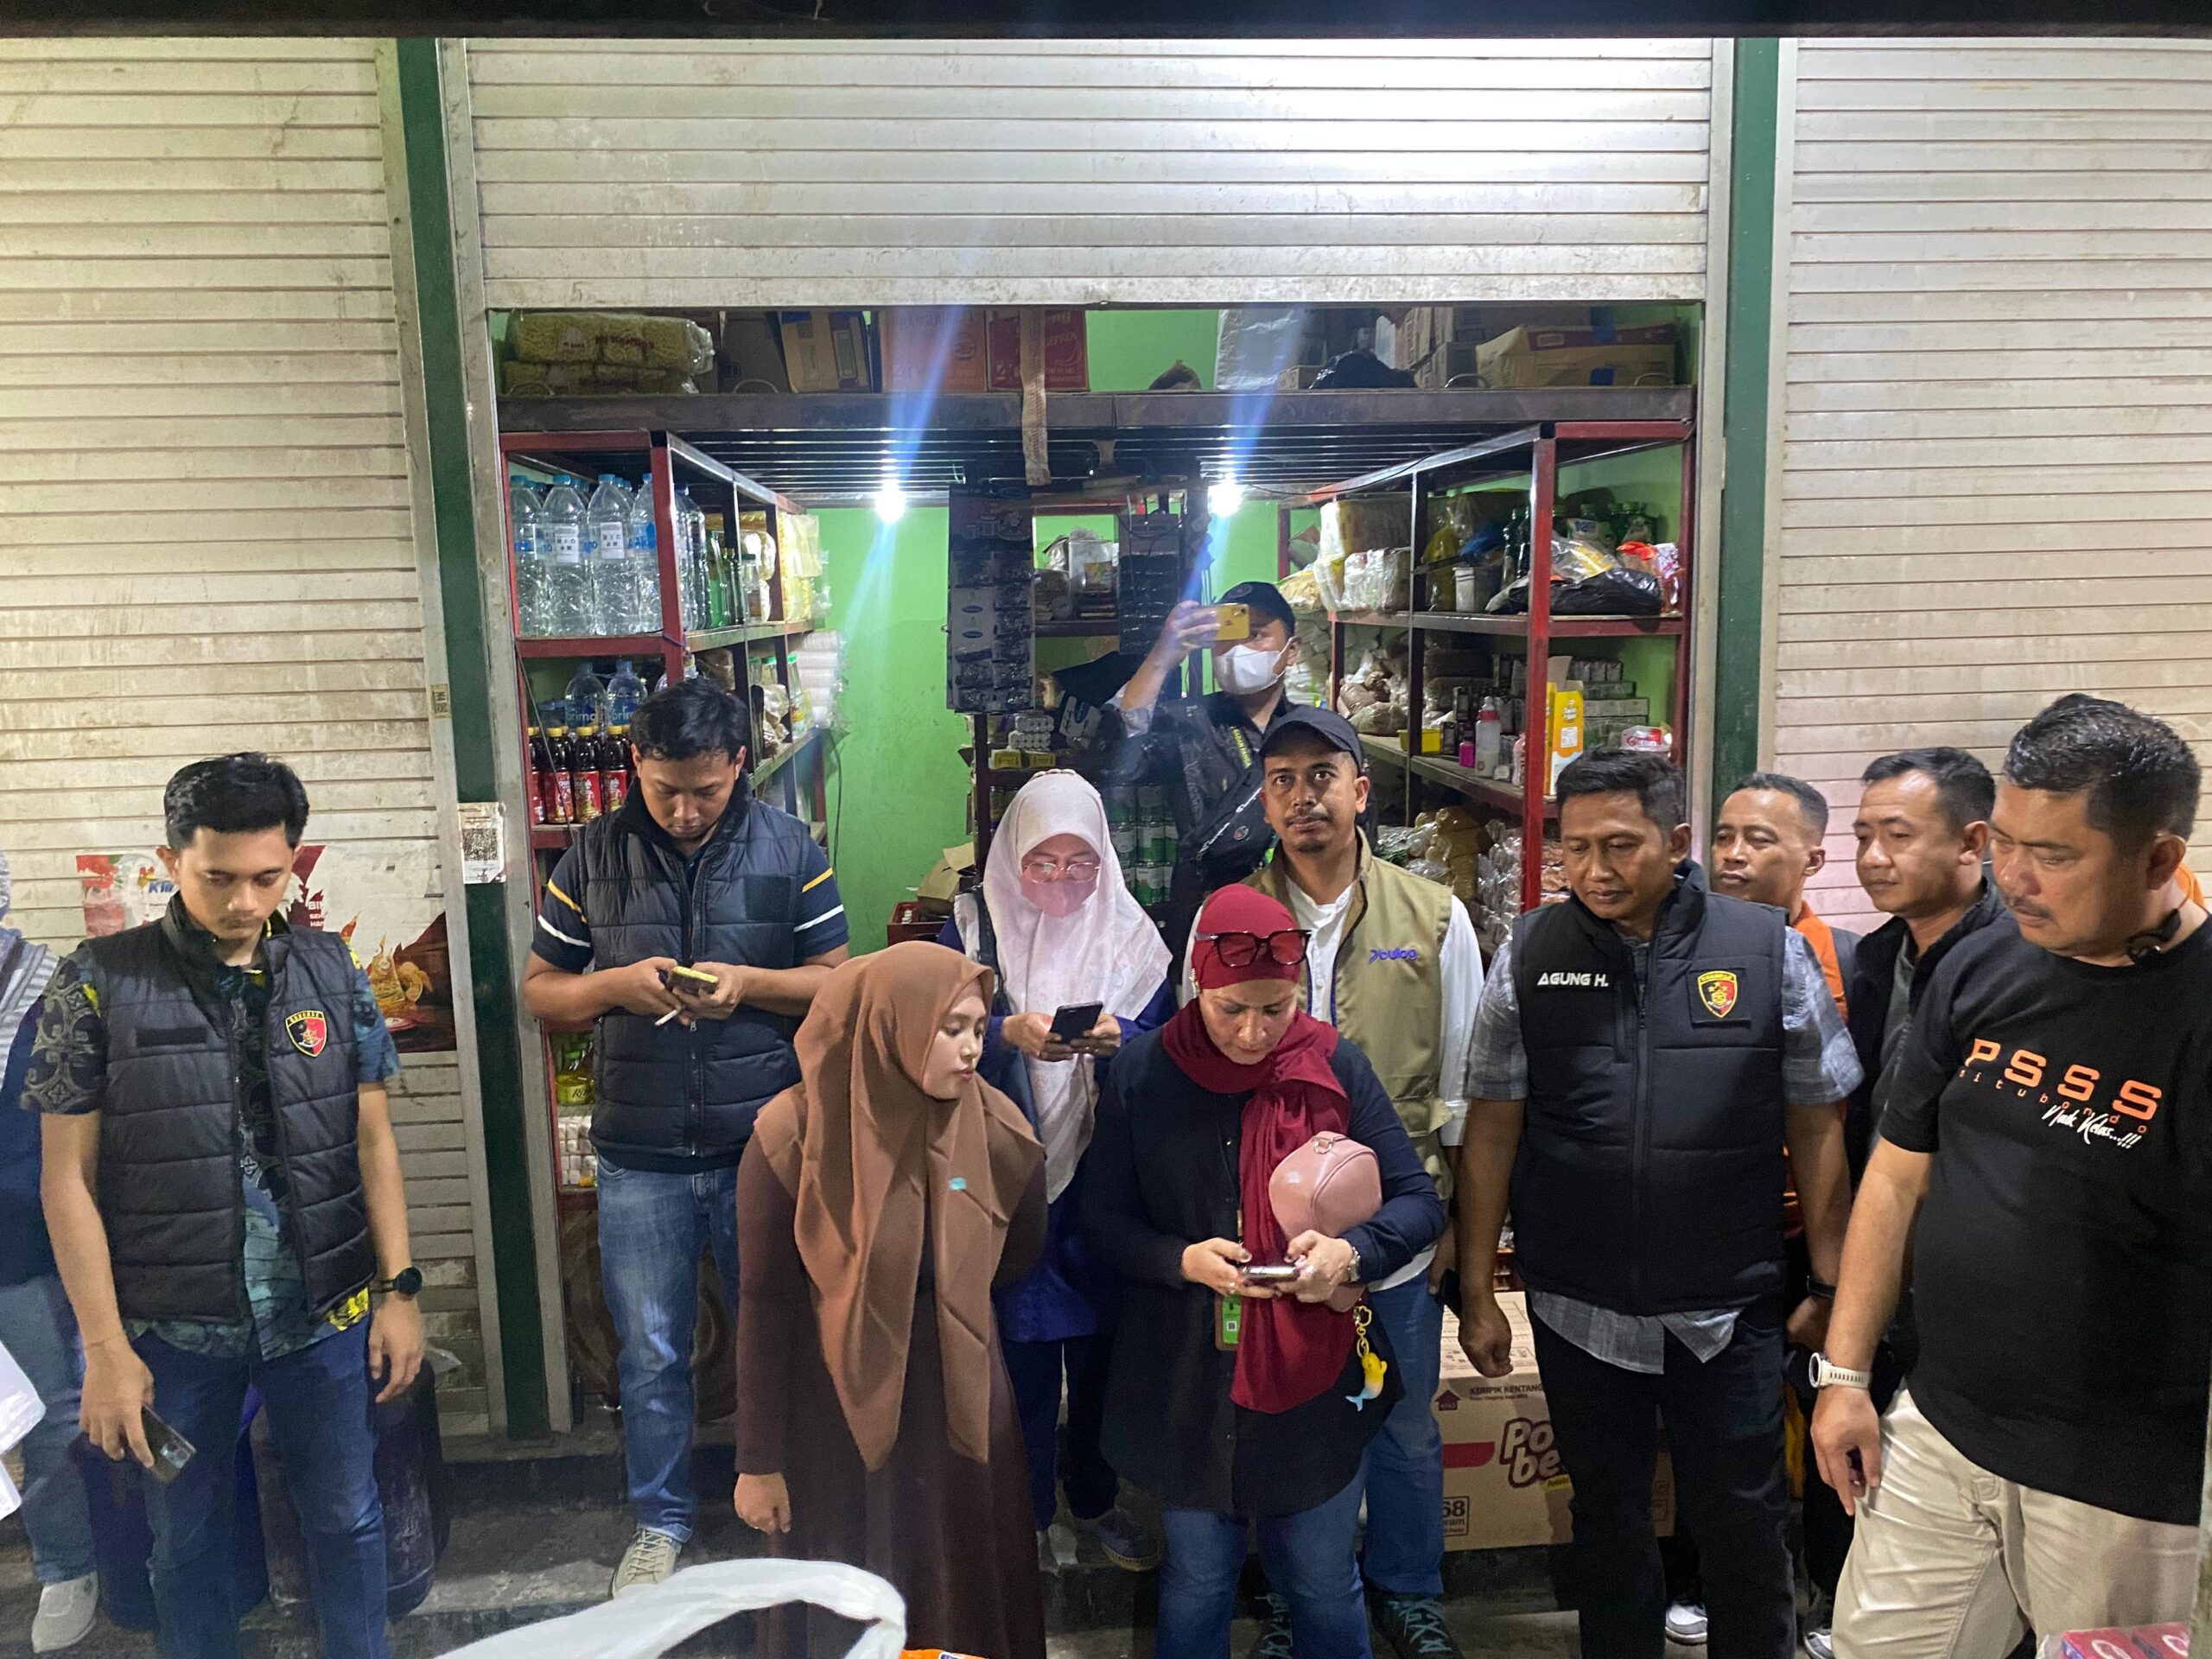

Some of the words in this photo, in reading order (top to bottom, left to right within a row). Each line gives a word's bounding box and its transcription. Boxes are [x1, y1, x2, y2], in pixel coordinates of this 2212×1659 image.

[1536, 972, 1592, 987] AGUNG
[1593, 973, 1610, 988] H.
[1964, 1038, 2163, 1121] PSSS
[1959, 1068, 2148, 1135] situbondo
[1469, 1386, 1503, 1395] KERIPIK
[1500, 1418, 1554, 1465] Po
[1509, 1446, 1564, 1488] be
[1442, 1518, 1465, 1527] ram
